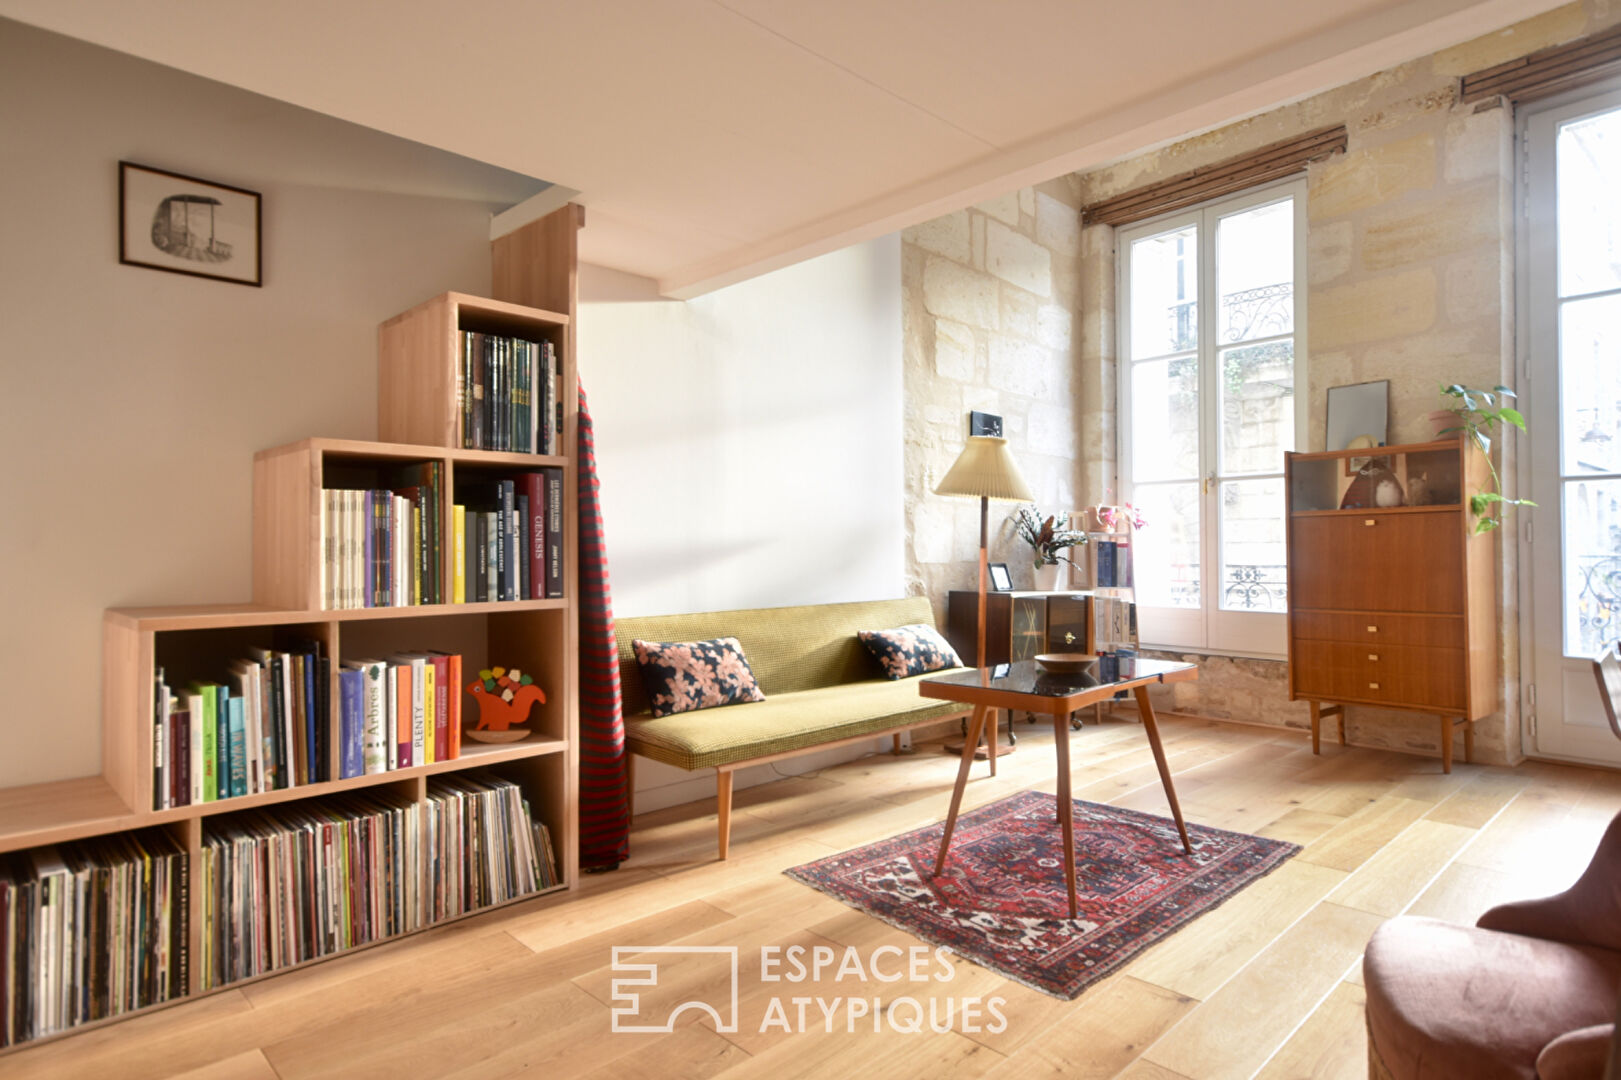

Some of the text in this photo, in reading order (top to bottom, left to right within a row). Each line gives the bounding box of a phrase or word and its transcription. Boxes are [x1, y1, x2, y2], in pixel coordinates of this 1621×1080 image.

[535, 515, 543, 559] GENESIS
[367, 687, 379, 737] Arbres
[415, 707, 423, 748] PLENTY
[231, 732, 245, 780] IN WAVES
